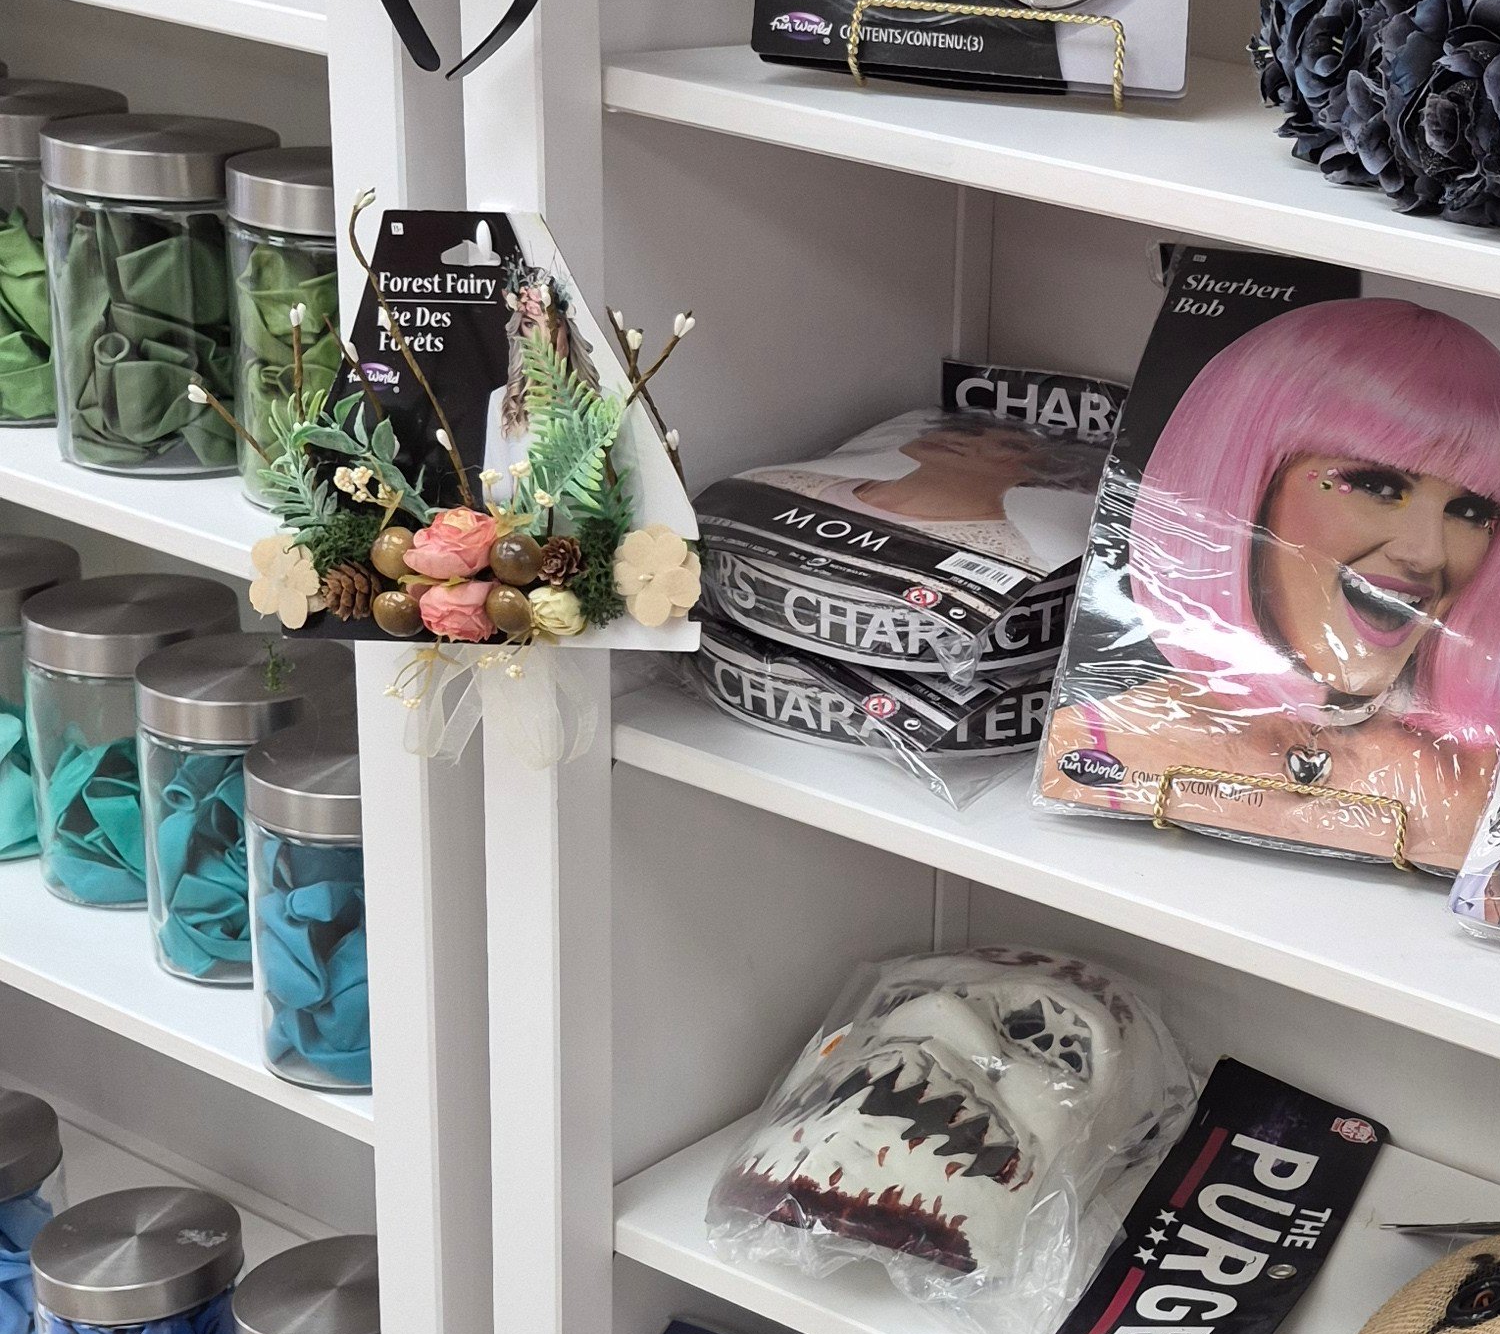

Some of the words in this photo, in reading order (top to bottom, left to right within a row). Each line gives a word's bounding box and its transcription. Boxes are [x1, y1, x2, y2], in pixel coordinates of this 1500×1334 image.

[794, 19, 833, 36] World
[378, 271, 442, 294] Forest
[446, 273, 497, 300] Fairy
[1182, 273, 1297, 303] Sherbert
[416, 306, 452, 328] Des
[1172, 296, 1225, 318] Bob
[378, 331, 445, 352] Forêts
[366, 370, 400, 384] World
[773, 508, 890, 553] MOM
[1084, 758, 1128, 781] World
[1282, 1206, 1333, 1250] THE
